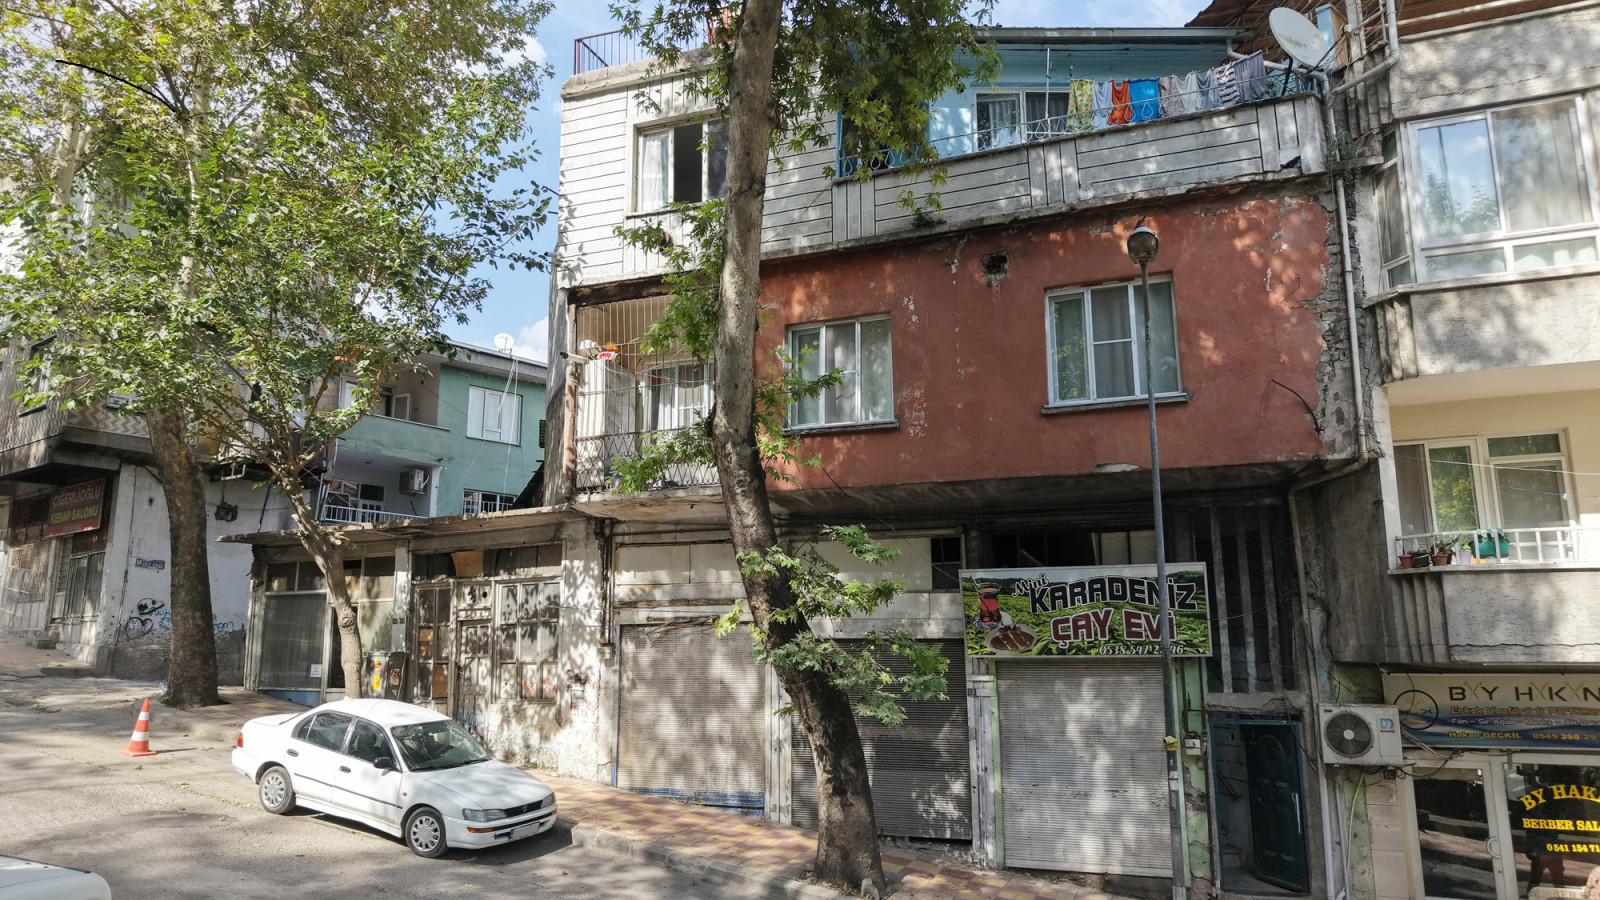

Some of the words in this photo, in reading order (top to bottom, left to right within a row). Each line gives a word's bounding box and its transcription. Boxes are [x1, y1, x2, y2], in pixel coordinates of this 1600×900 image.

[71, 504, 99, 520] SALONU
[1012, 573, 1049, 598] Mini
[1028, 575, 1197, 614] KARADENİZ
[1051, 607, 1114, 649] ÇAY
[1100, 645, 1126, 655] 0538
[1130, 645, 1149, 655] 547
[1450, 706, 1484, 715] Erkek
[1448, 731, 1480, 739] Hakan
[1532, 732, 1558, 740] 0545
[1560, 732, 1580, 740] 350
[1520, 788, 1546, 811] BY
[1522, 818, 1575, 830] BERBER
[1571, 844, 1588, 852] 154
